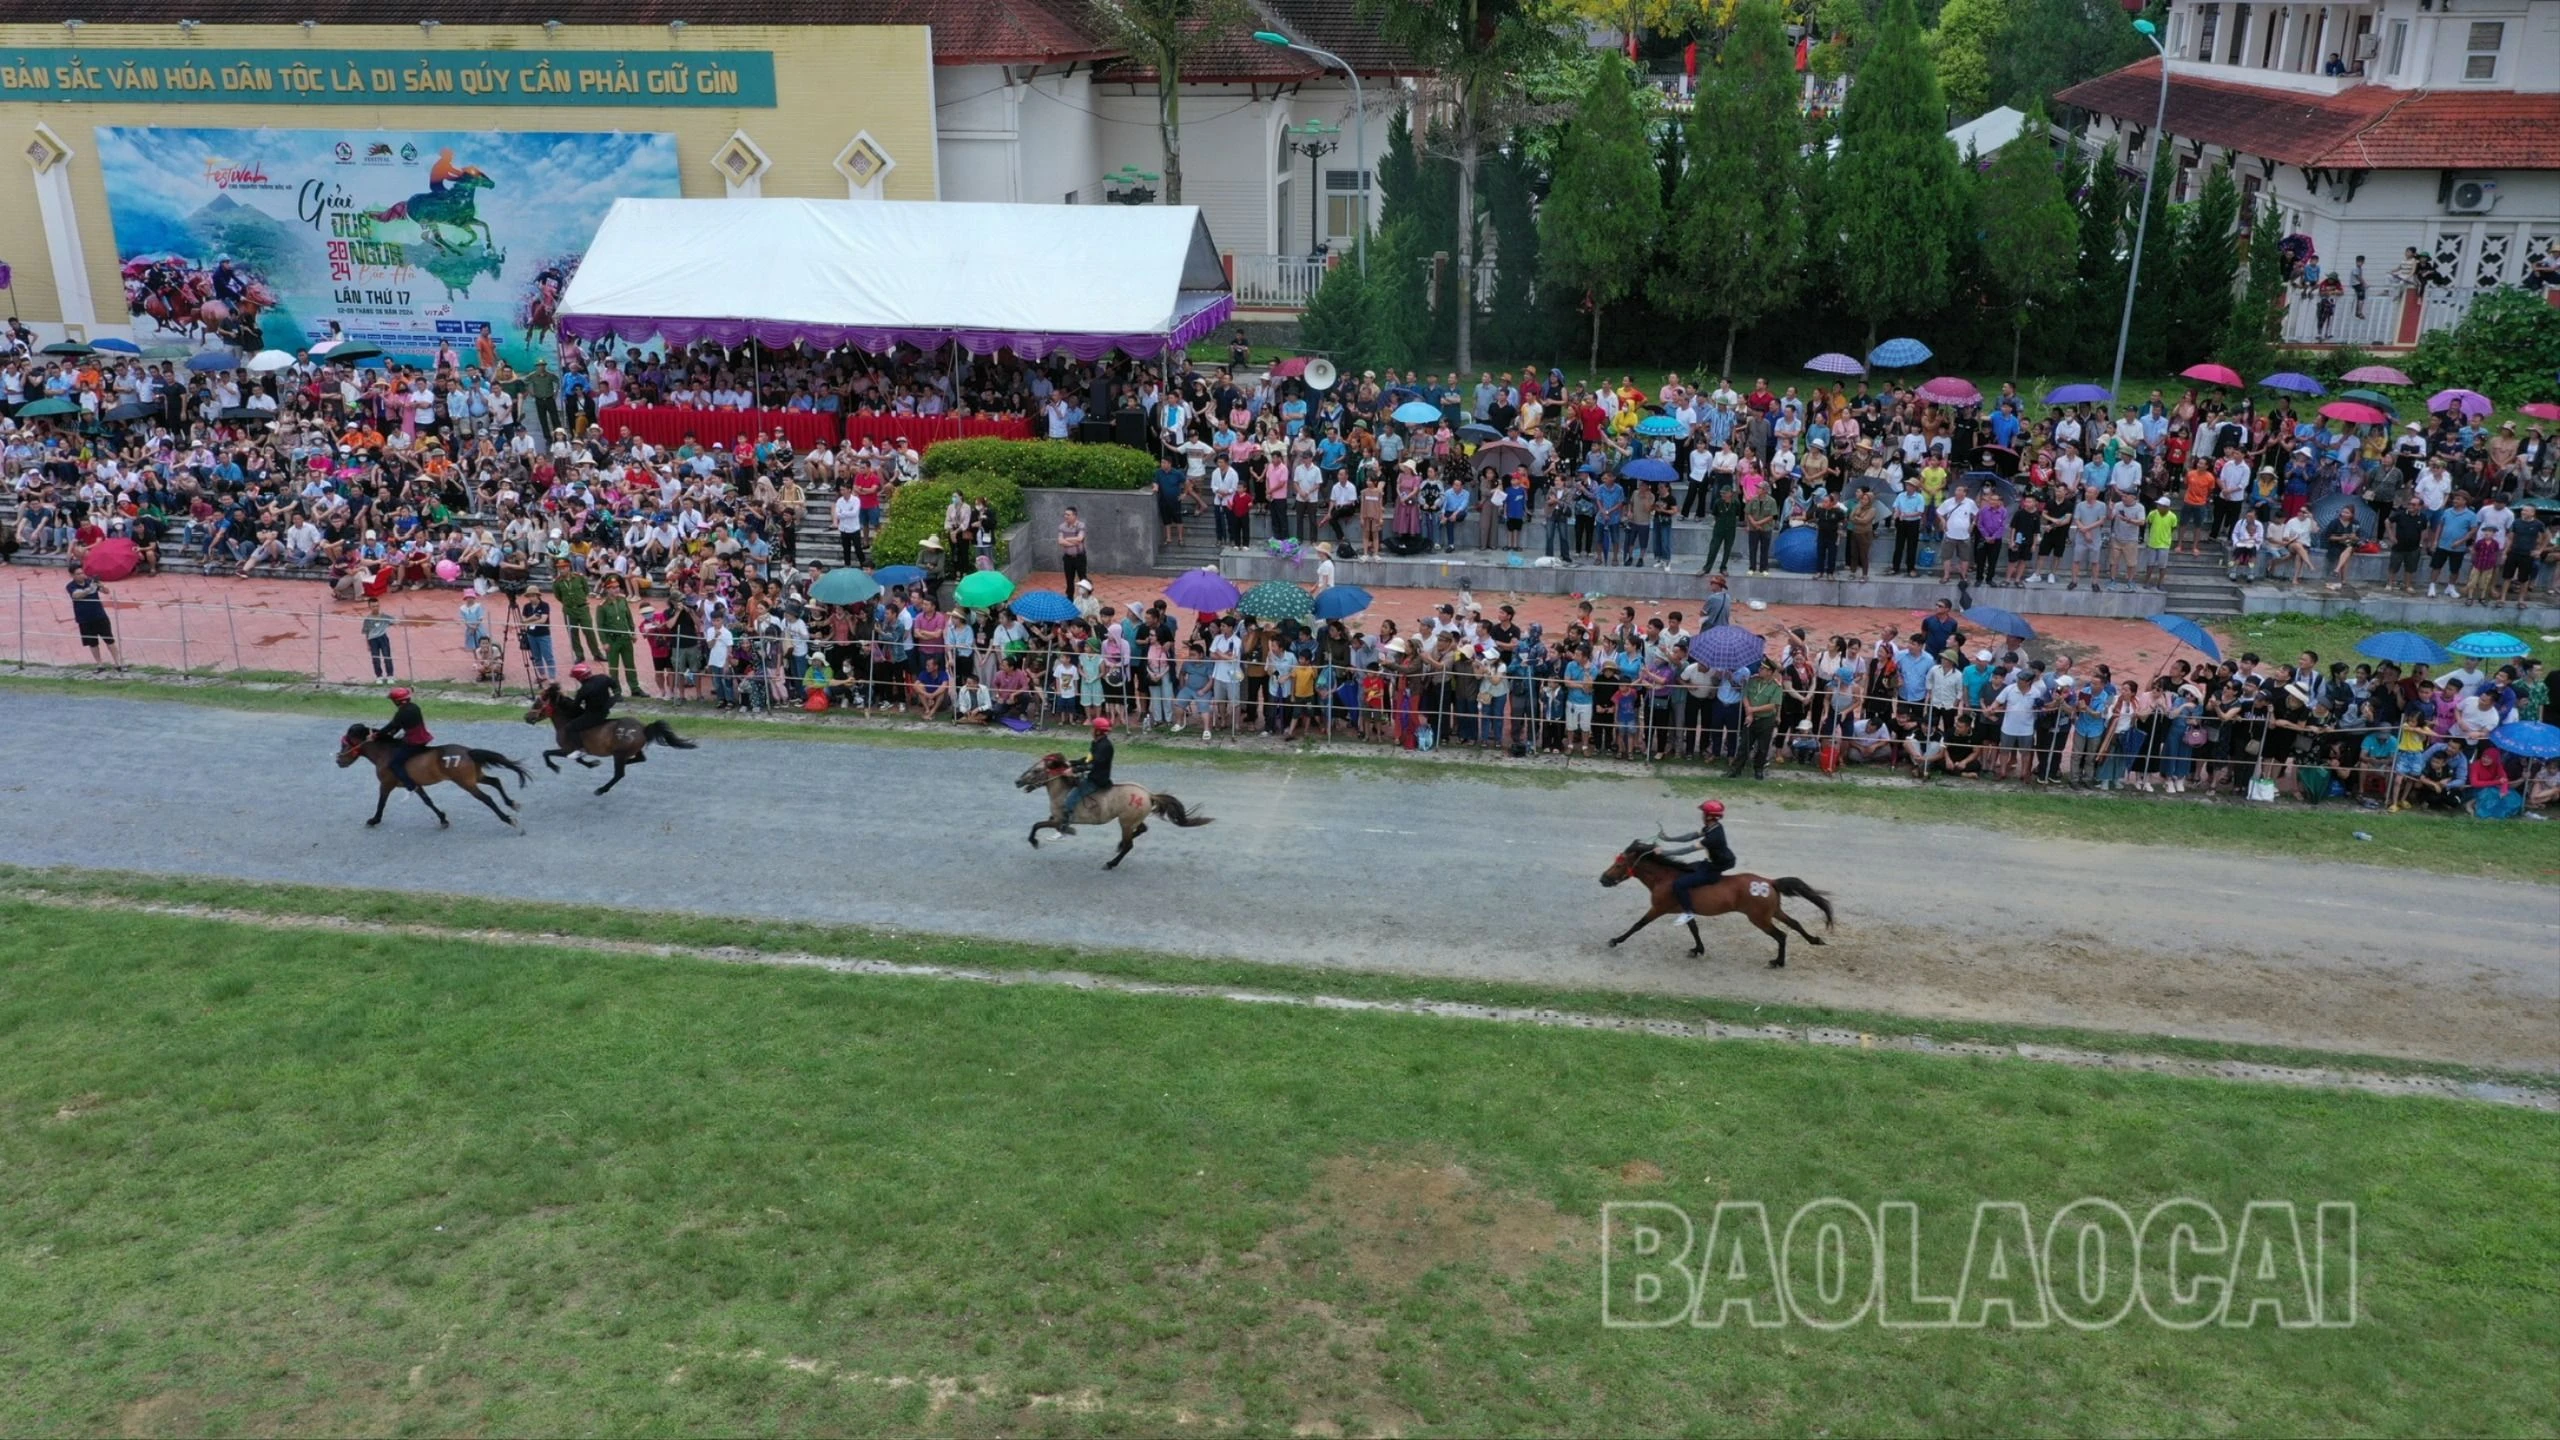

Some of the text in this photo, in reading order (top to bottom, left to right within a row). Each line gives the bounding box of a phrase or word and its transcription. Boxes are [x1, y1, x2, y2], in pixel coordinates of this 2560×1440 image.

[1, 57, 50, 89] BẢN
[55, 55, 103, 90] SẮC
[106, 60, 159, 90] VĂN
[163, 60, 217, 90] HÓA
[221, 61, 273, 90] DÂN
[278, 61, 326, 97] TỘC
[331, 60, 366, 92] LÀ
[371, 69, 397, 92] DI
[403, 59, 454, 93] SẢN
[519, 58, 572, 93] CẦN
[579, 59, 640, 93] PHẢI
[647, 62, 690, 94] GIỮ
[696, 62, 739, 94] GÌN
[298, 179, 355, 231] Giải
[327, 241, 348, 260] 20
[330, 262, 351, 281] 24
[335, 286, 410, 305] LẦN THỨ 17
[442, 755, 461, 769] 77
[1128, 794, 1144, 809] 14
[1750, 881, 1770, 898] 86
